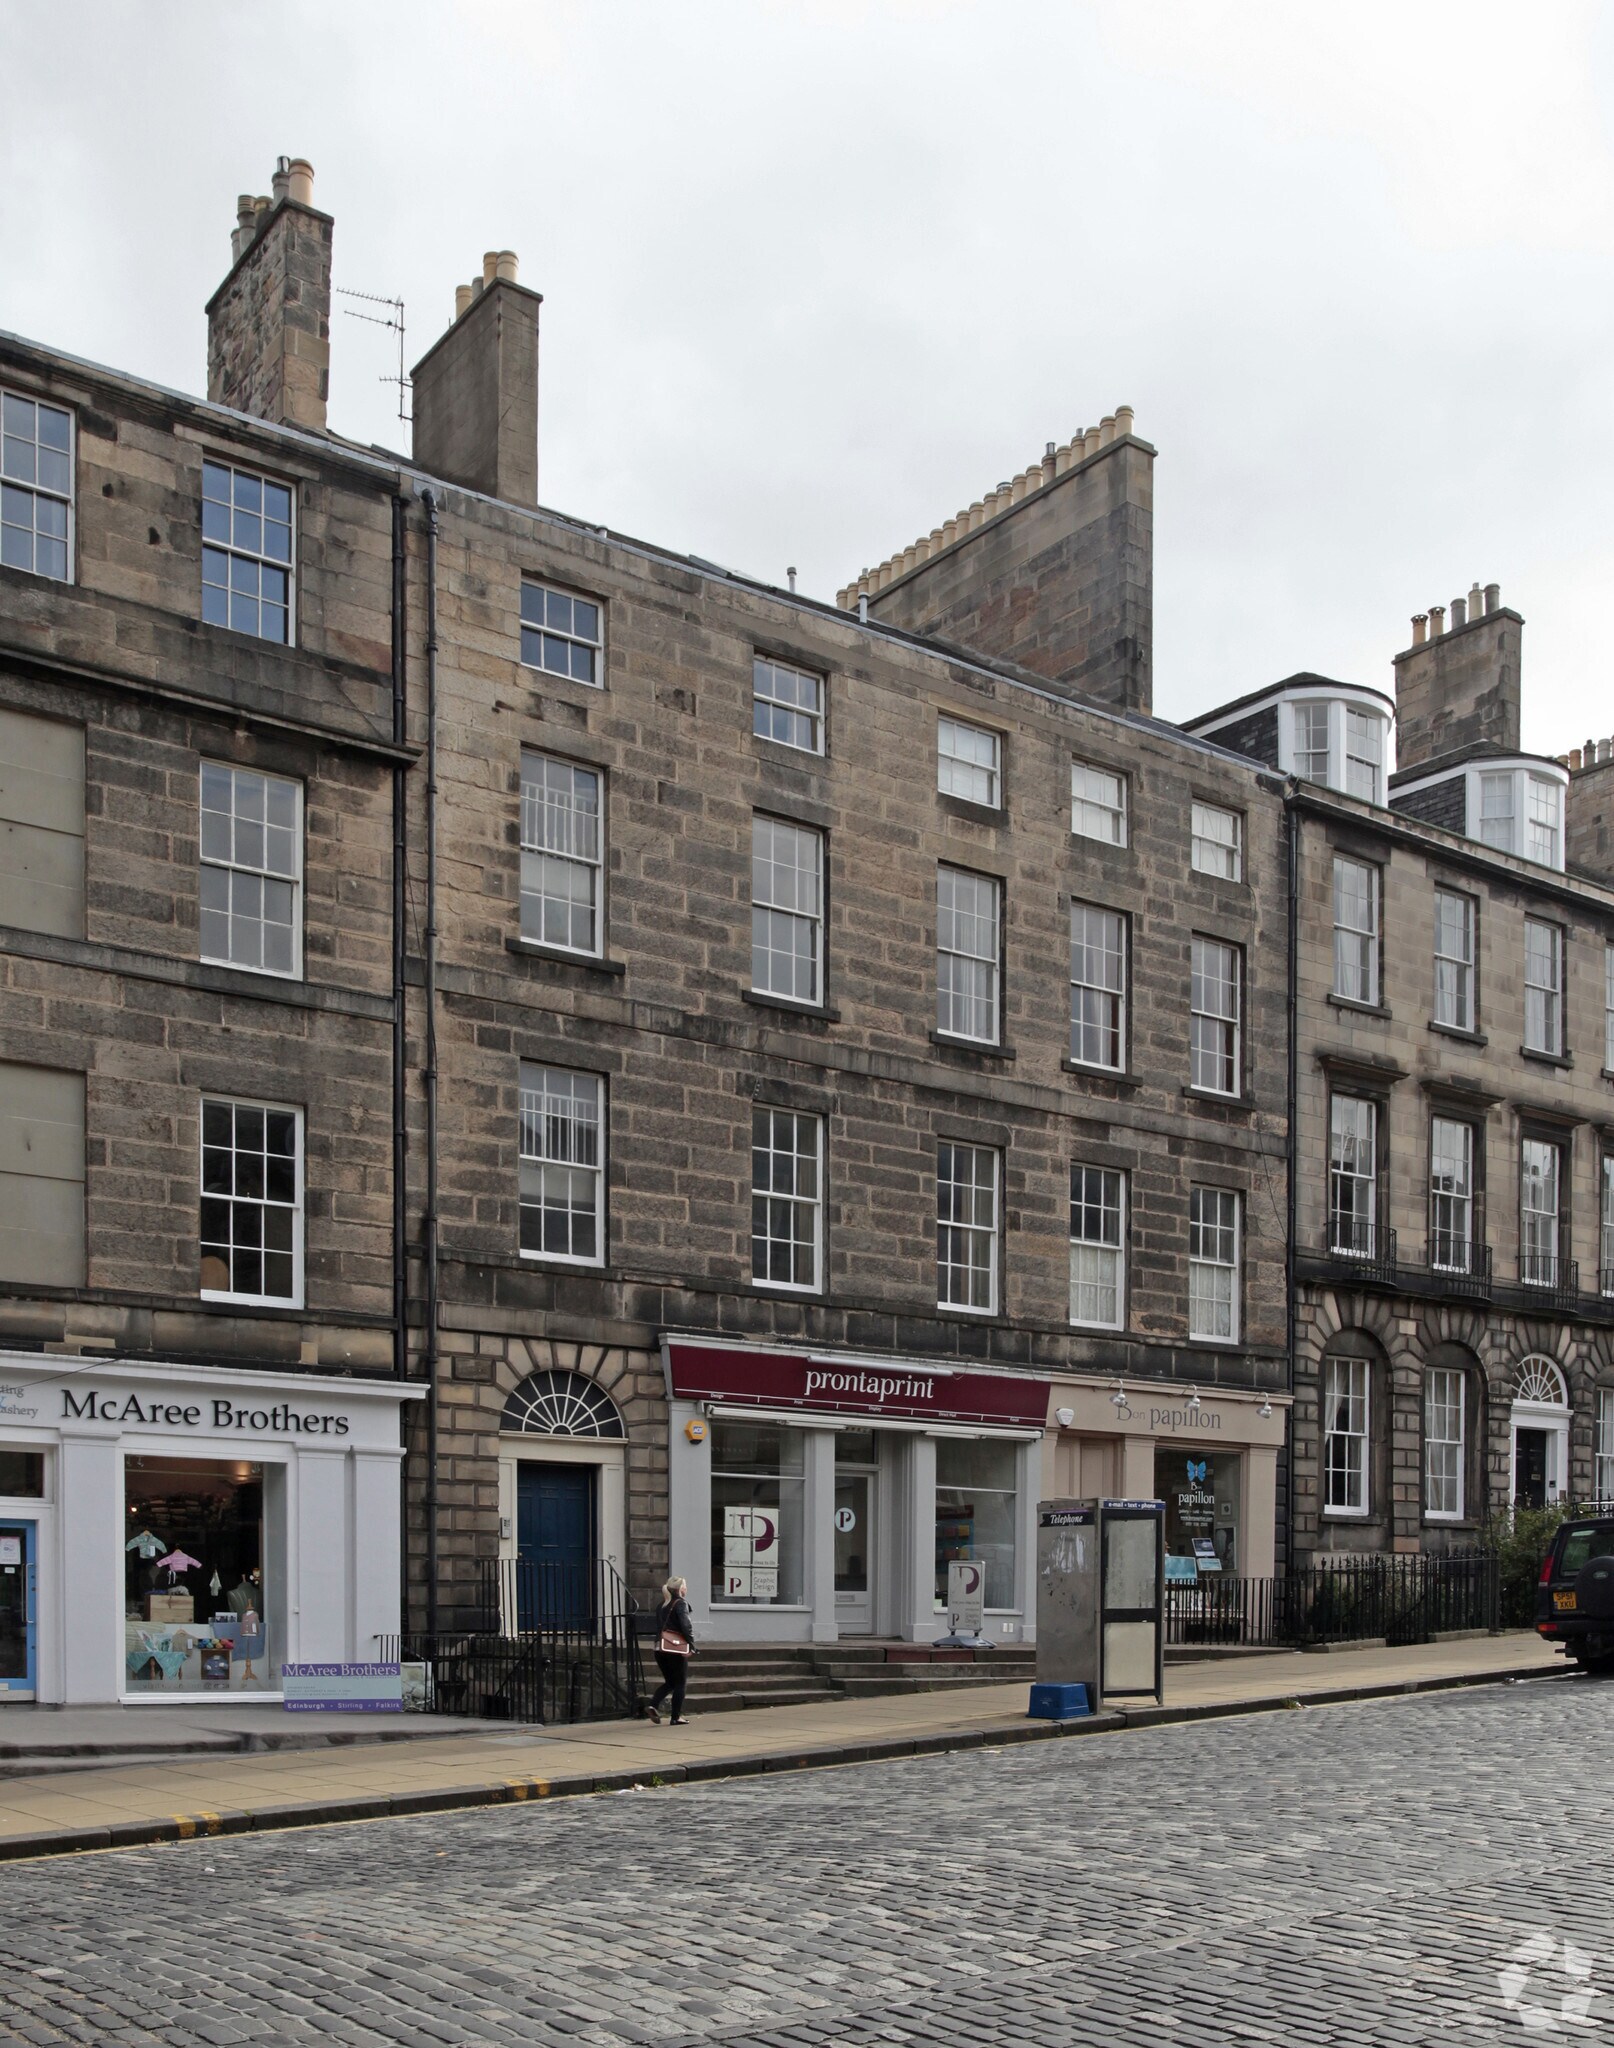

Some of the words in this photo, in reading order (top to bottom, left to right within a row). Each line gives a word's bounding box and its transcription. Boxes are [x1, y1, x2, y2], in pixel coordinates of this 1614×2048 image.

[804, 1370, 934, 1402] prontaprint
[61, 1389, 200, 1424] McAree
[211, 1400, 349, 1434] Brothers
[1150, 1406, 1222, 1432] papillon
[1178, 1490, 1215, 1507] papillon
[839, 1511, 852, 1528] P
[1050, 1513, 1084, 1526] Telephone
[729, 1577, 742, 1594] P
[753, 1583, 775, 1592] Design
[285, 1664, 338, 1676] McAree
[341, 1663, 398, 1676] Brothers
